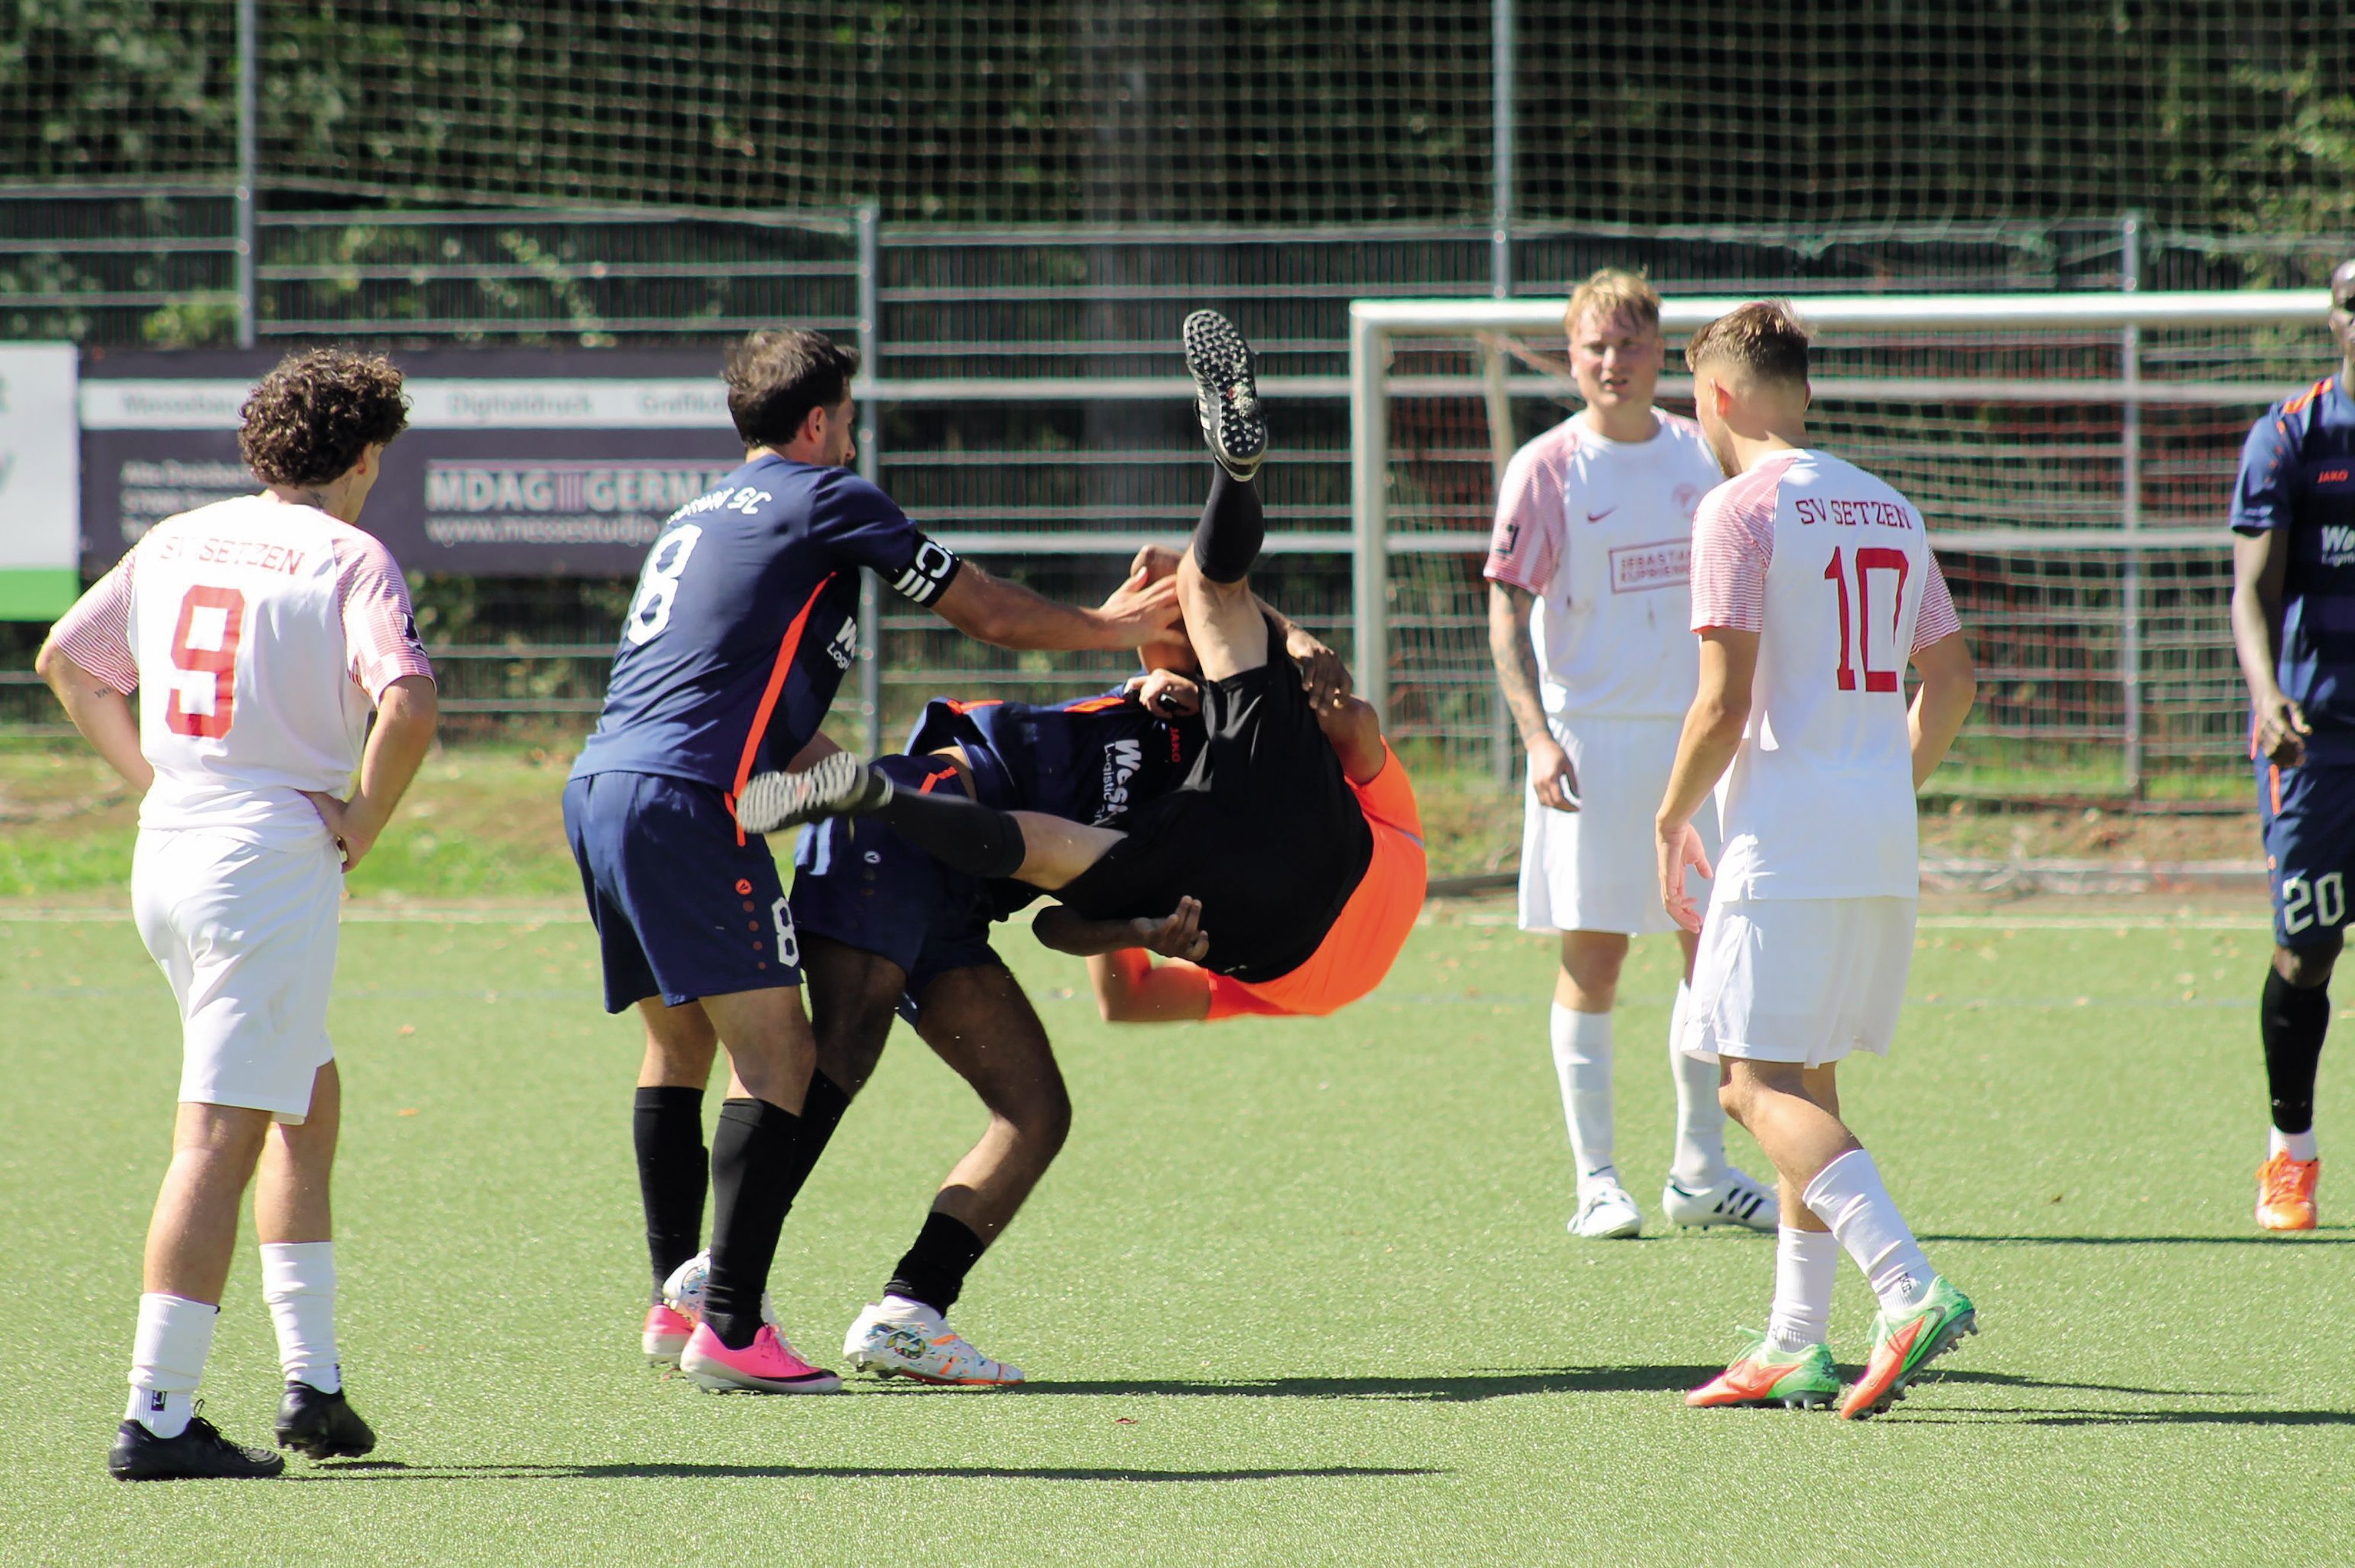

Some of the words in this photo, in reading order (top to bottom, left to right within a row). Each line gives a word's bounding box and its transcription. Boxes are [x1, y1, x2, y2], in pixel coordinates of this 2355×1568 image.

[425, 469, 553, 512] MDAG
[727, 486, 772, 514] SC
[1796, 498, 1826, 525] SV
[1830, 500, 1912, 529] SETZEN
[198, 538, 306, 575] SETZEN
[627, 523, 702, 646] 8
[1824, 545, 1909, 692] 10
[165, 585, 246, 740] 9
[771, 897, 800, 967] 8
[2284, 871, 2346, 935] 20
